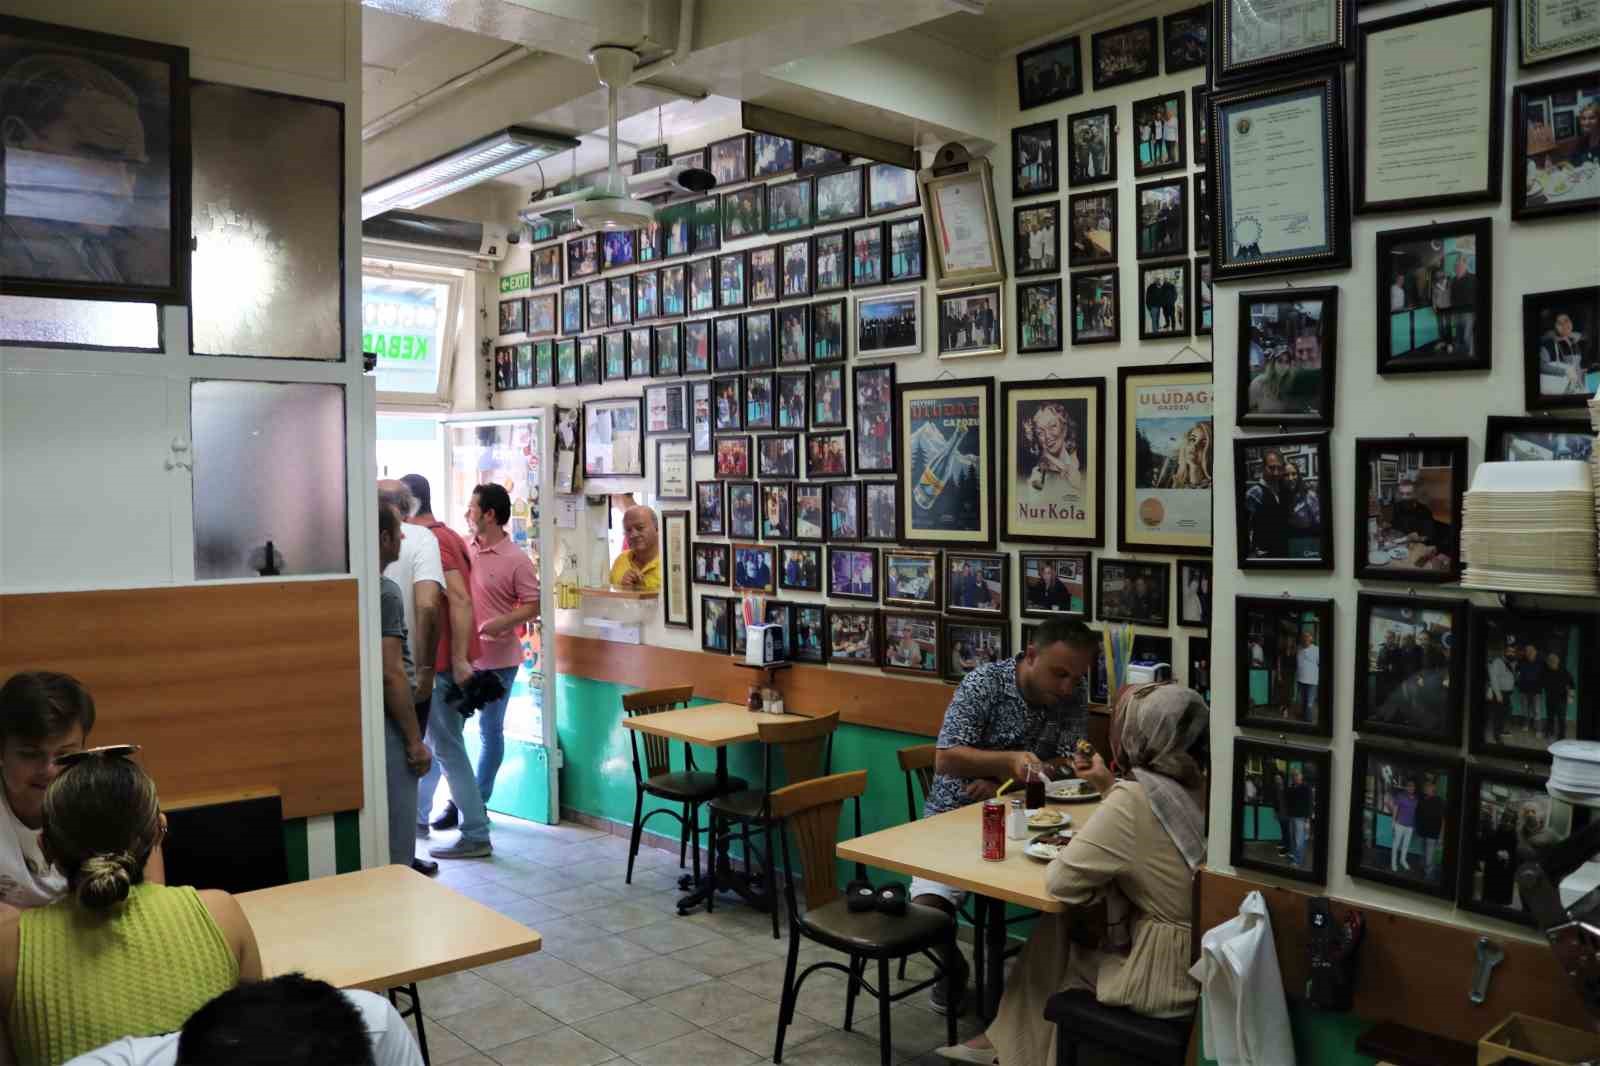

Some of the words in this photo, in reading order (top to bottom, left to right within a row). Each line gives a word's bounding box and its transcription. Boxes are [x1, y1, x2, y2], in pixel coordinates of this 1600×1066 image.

[510, 274, 528, 288] EXIT
[1018, 502, 1046, 520] Nur
[1048, 503, 1086, 520] Kola
